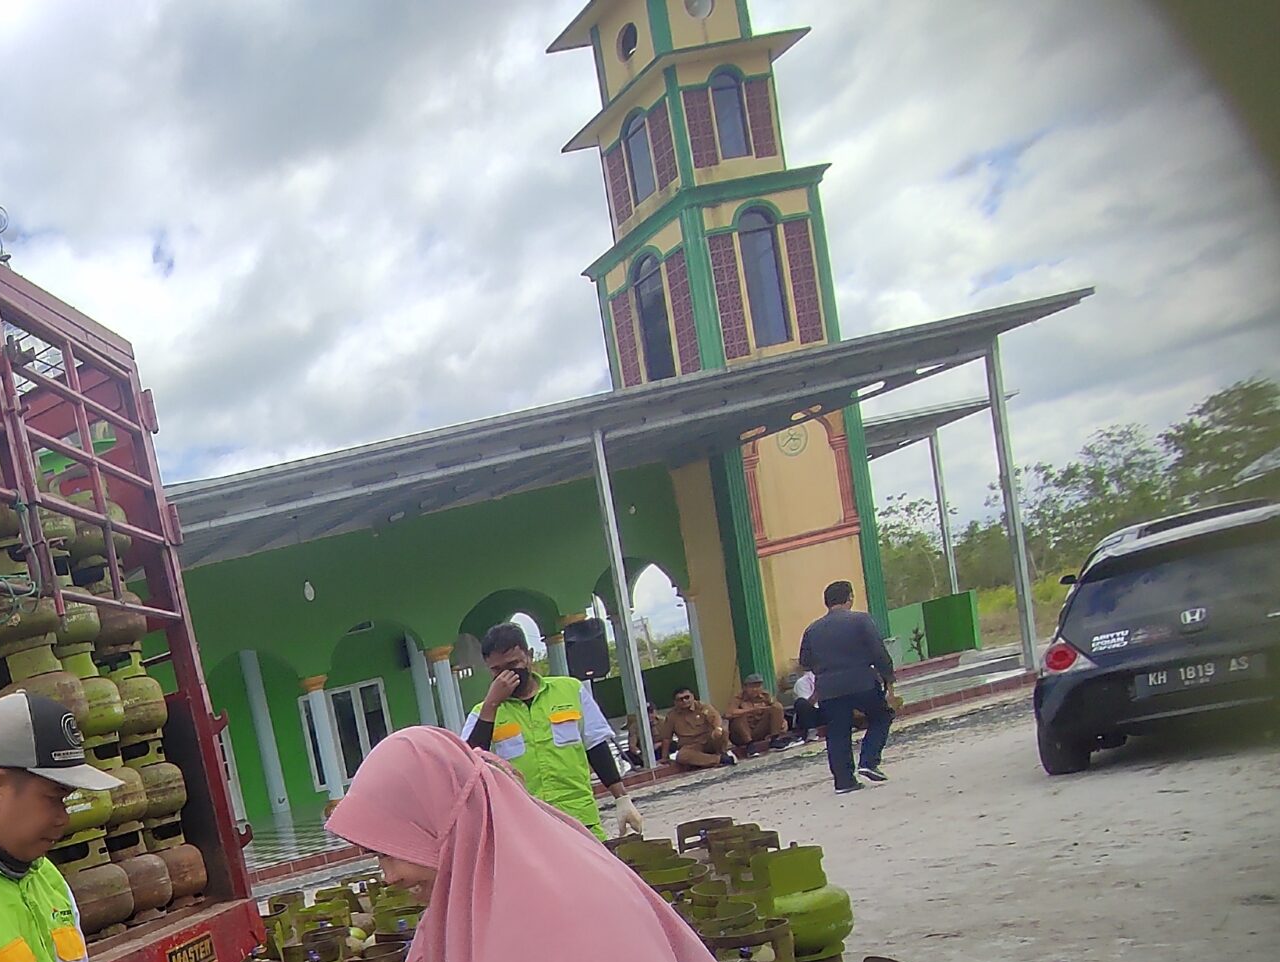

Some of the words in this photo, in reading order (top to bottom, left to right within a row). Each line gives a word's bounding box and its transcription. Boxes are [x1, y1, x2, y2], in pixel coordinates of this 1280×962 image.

[1148, 671, 1168, 686] KH
[1179, 662, 1215, 680] 1819
[1229, 656, 1249, 671] AS
